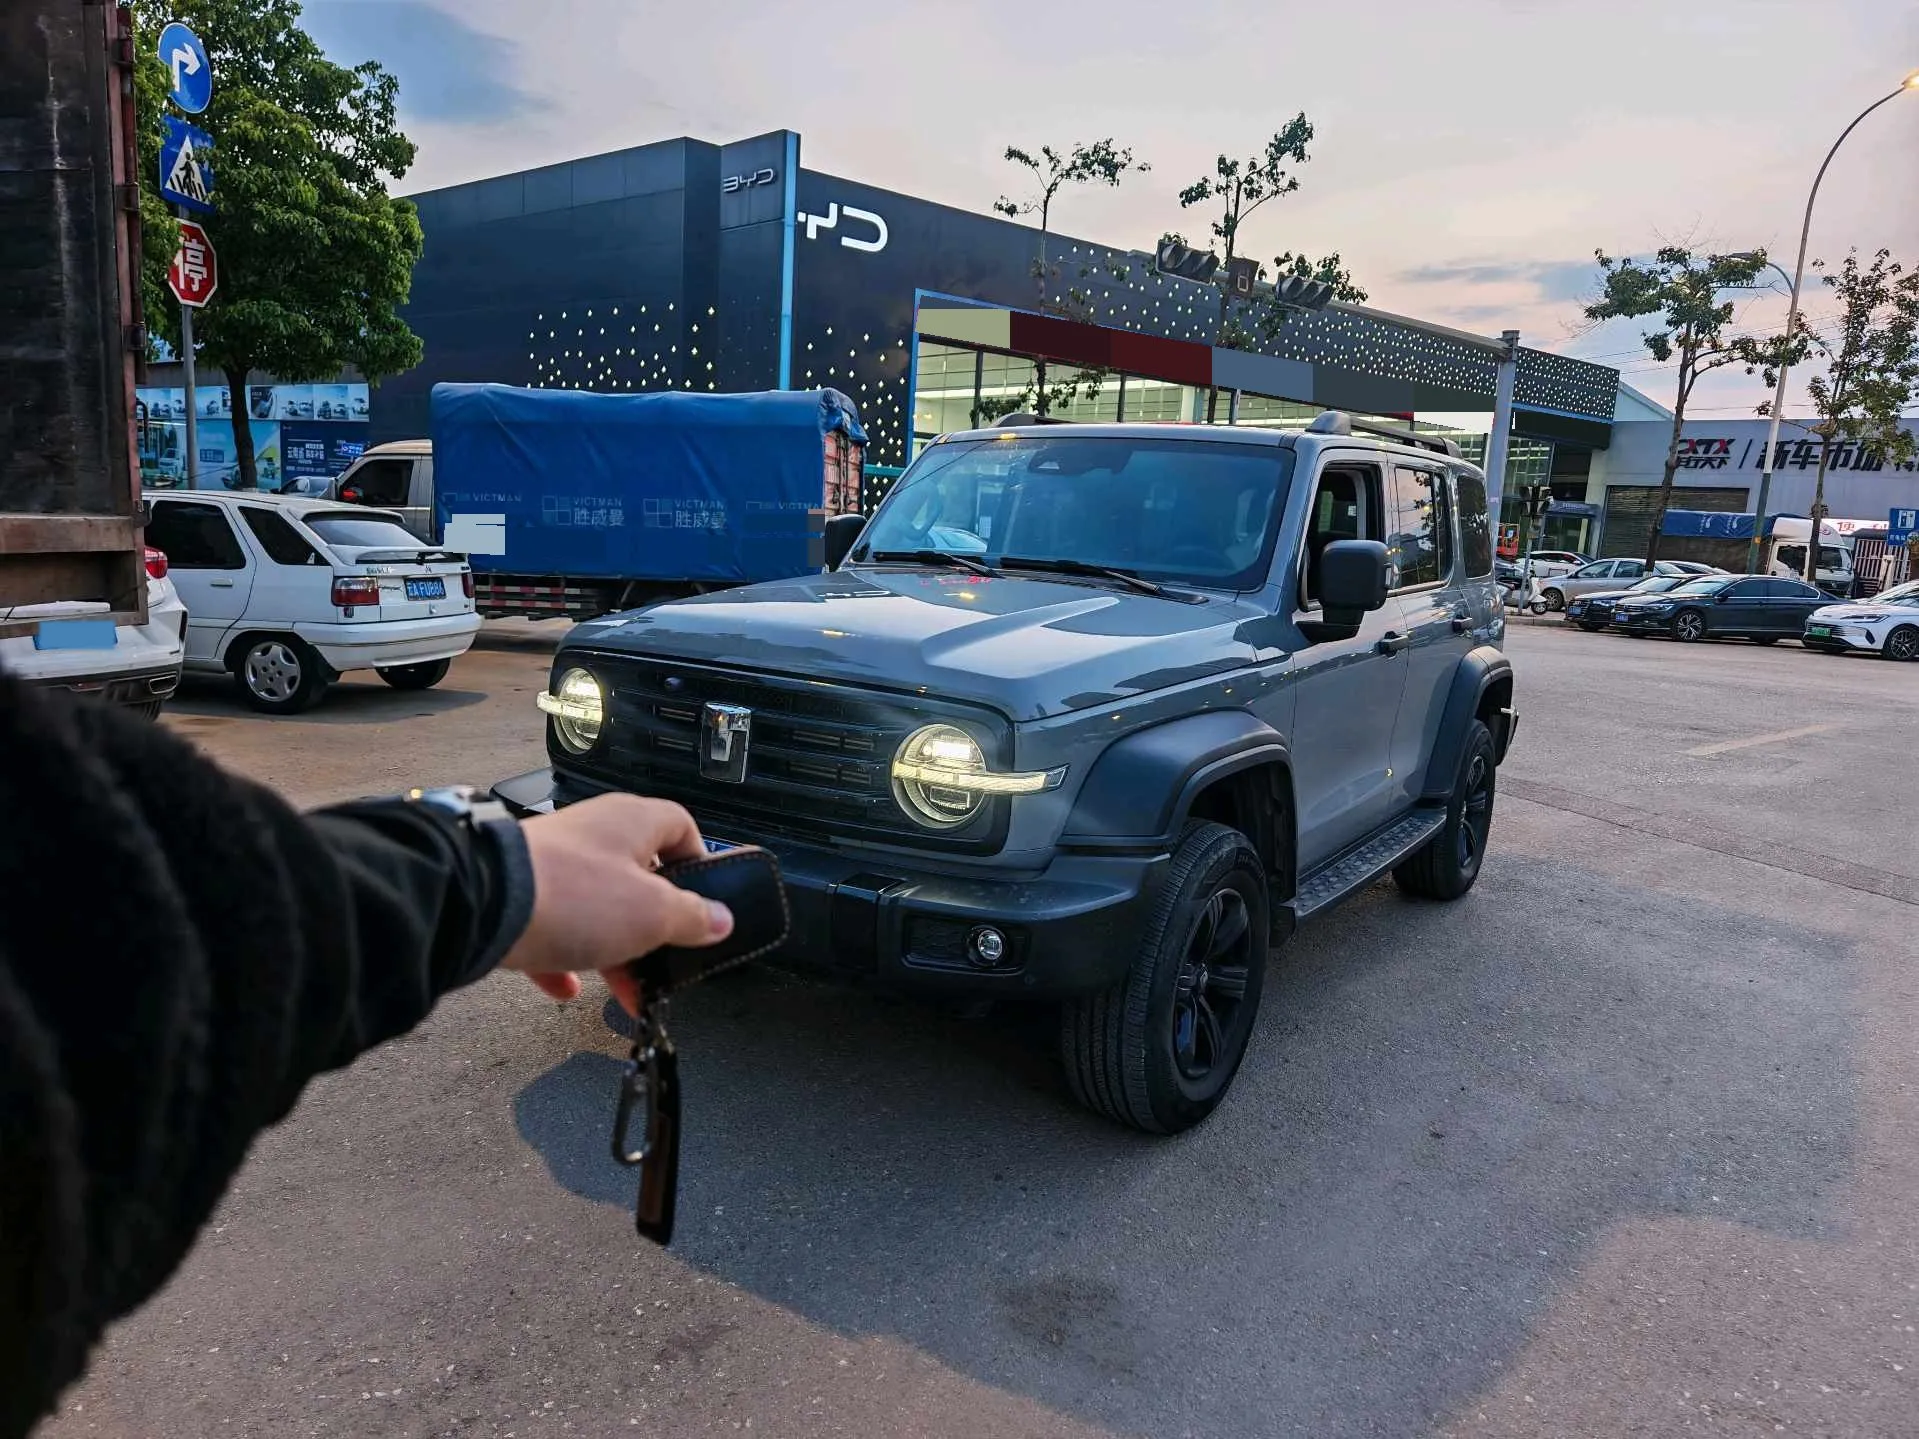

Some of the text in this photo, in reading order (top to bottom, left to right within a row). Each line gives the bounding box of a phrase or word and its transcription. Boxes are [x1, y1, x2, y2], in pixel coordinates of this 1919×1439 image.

[723, 168, 774, 192] BYD
[797, 202, 888, 252] YD
[174, 236, 208, 292] 停
[573, 497, 622, 507] VICTMAN
[674, 499, 724, 509] VICTMAN
[778, 502, 824, 510] VICTMA
[675, 511, 726, 529] 胜威曼
